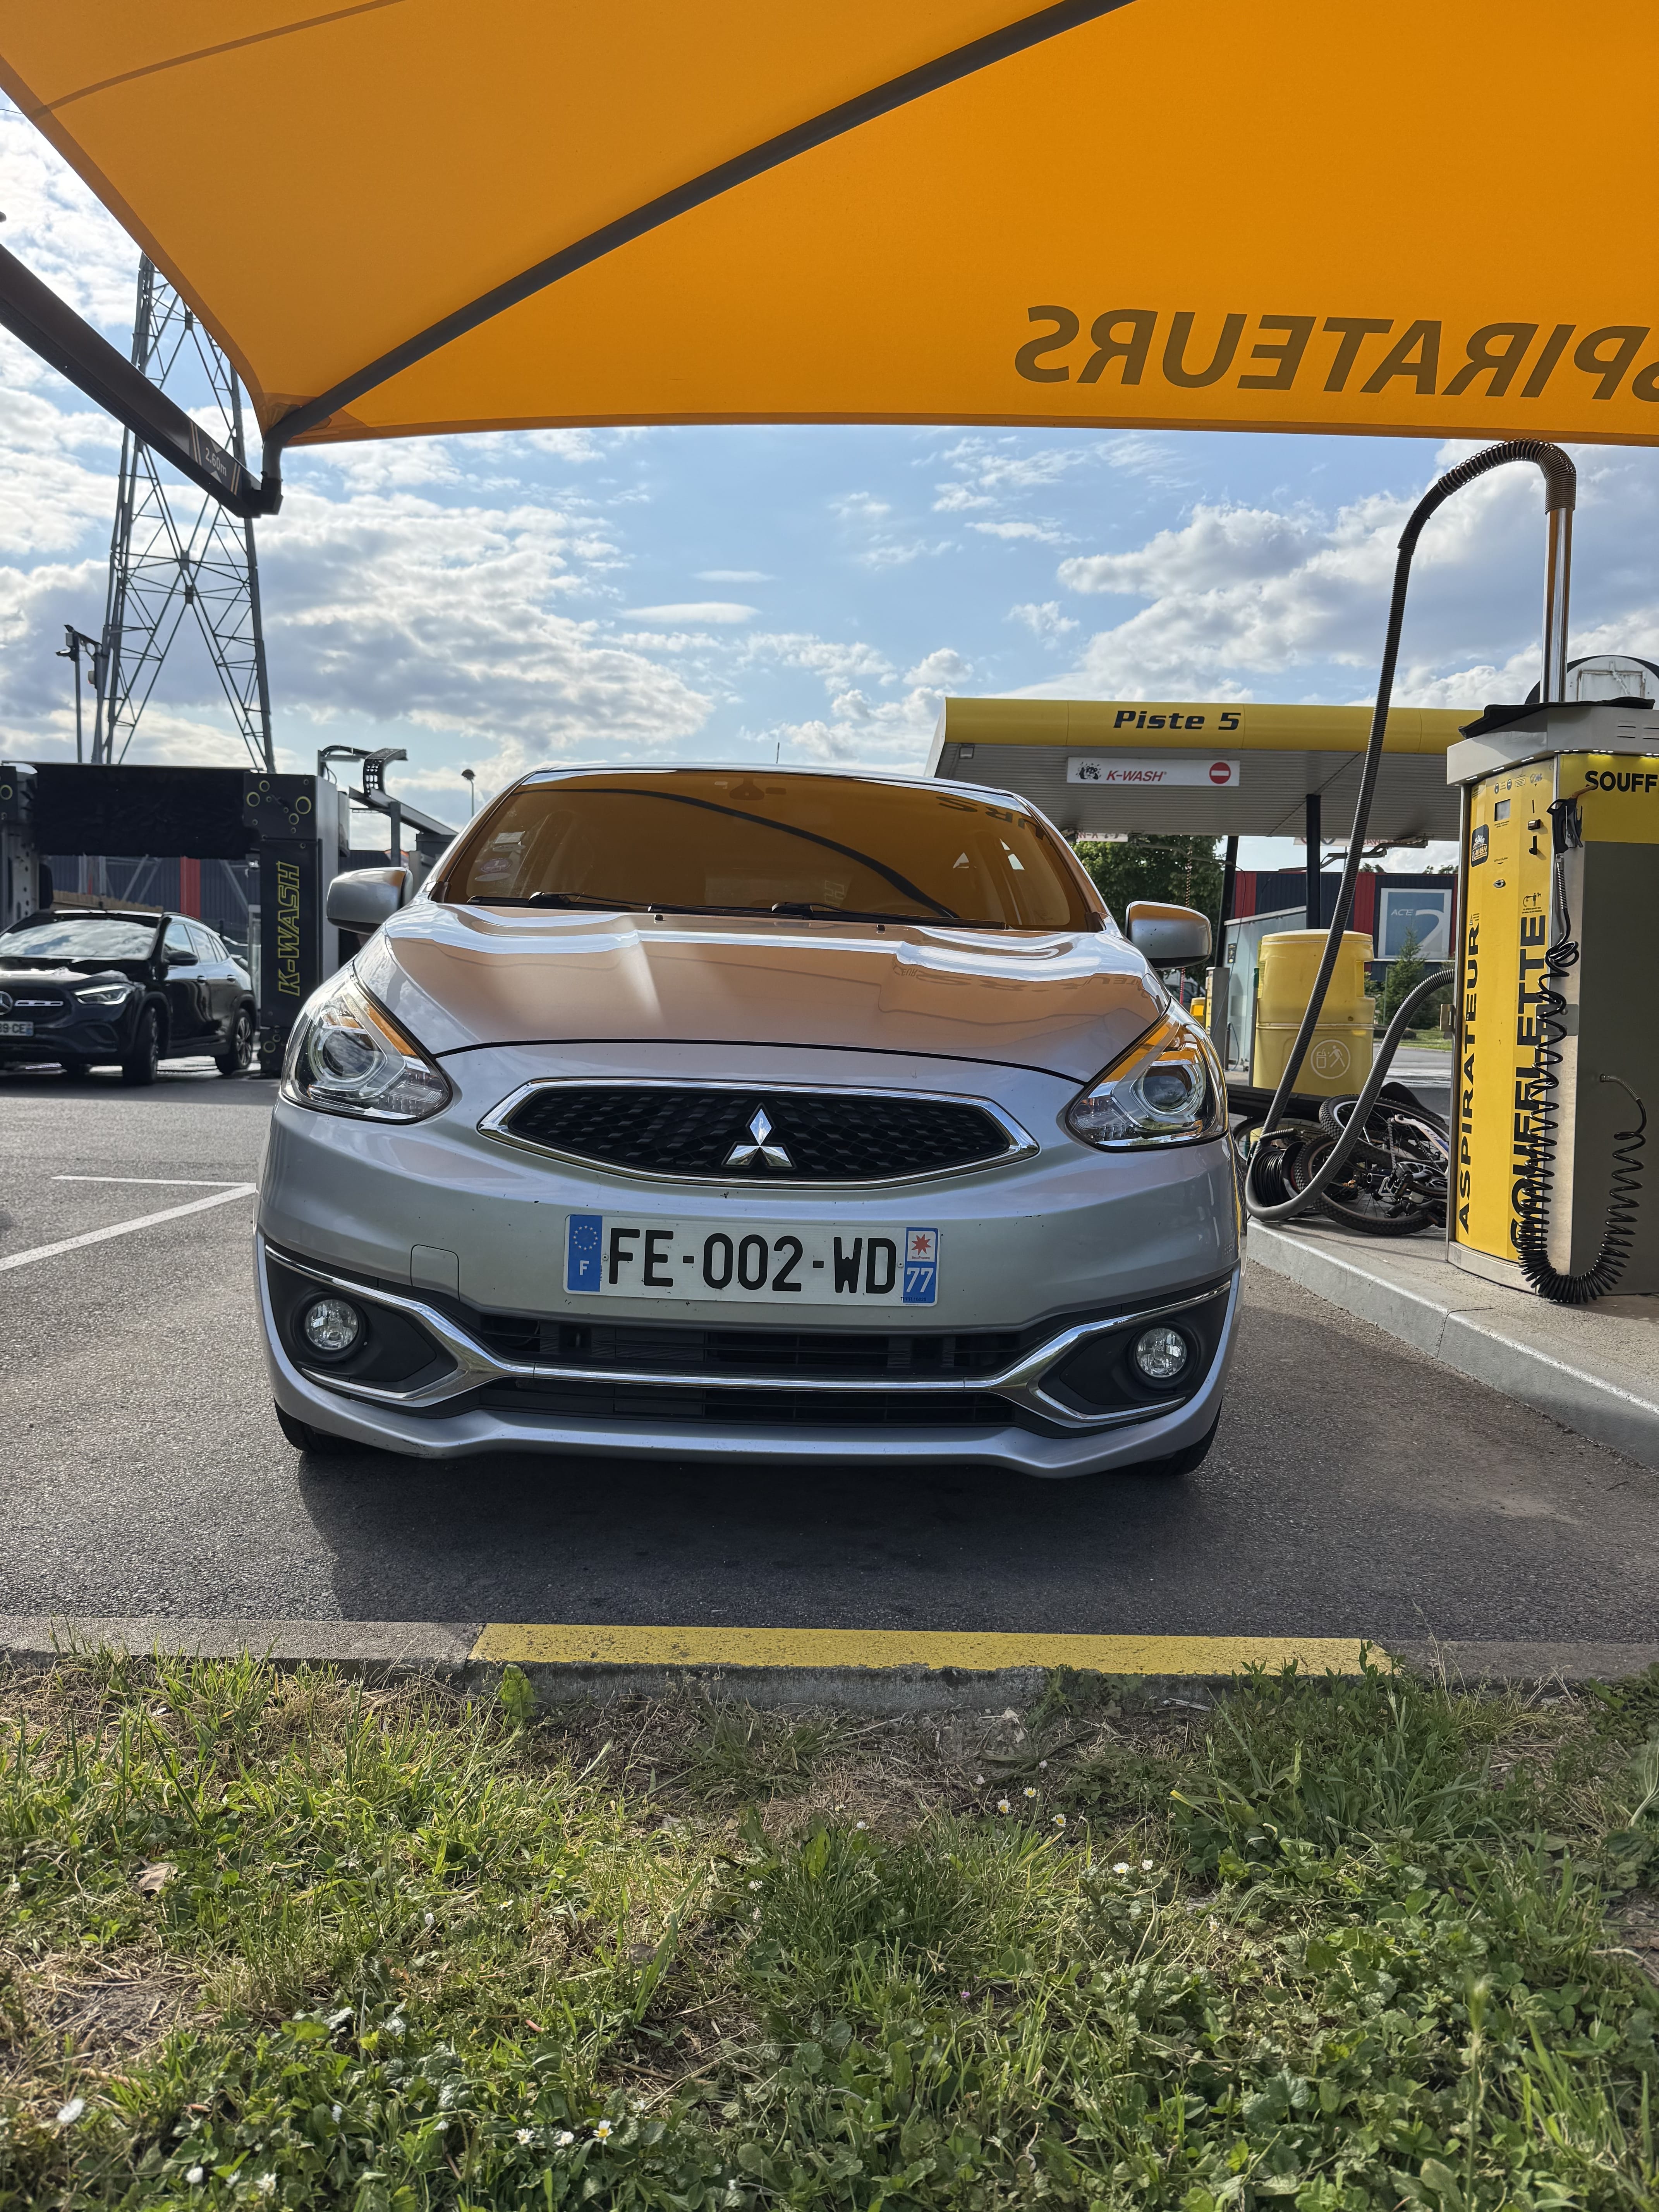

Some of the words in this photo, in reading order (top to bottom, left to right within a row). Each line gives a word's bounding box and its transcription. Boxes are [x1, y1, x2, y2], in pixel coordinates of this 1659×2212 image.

[205, 447, 227, 477] 2.60m
[1113, 710, 1205, 729] Piste
[1218, 712, 1241, 730] 5
[1585, 770, 1658, 793] SOUFF
[278, 860, 300, 997] K-WASH
[1459, 922, 1479, 1235] ASPIRATEUR
[579, 1260, 589, 1275] F
[609, 1227, 896, 1294] FE-002-WD
[906, 1267, 934, 1293] 77
